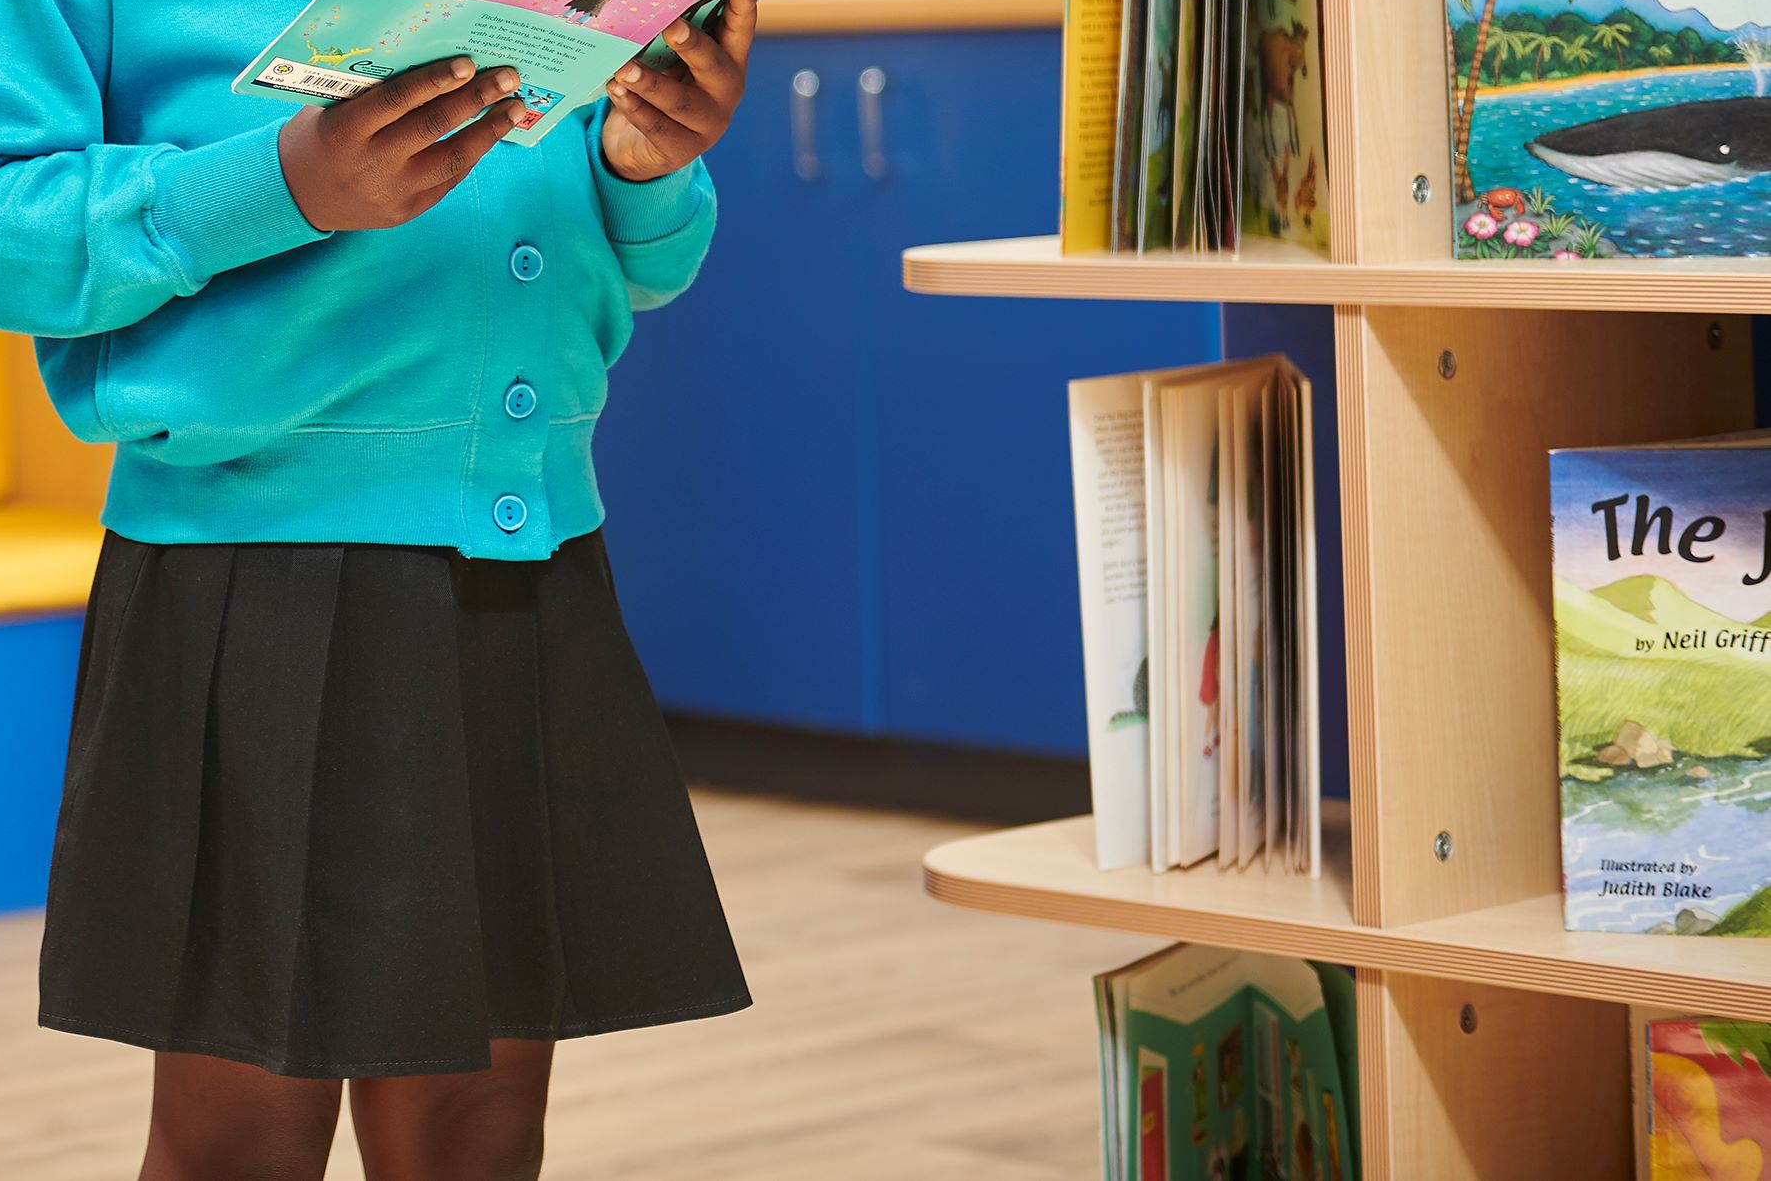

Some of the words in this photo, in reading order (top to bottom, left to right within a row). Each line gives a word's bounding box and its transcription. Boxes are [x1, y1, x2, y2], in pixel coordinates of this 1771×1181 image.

[496, 34, 513, 42] little
[541, 45, 556, 53] But
[556, 51, 577, 60] when
[549, 30, 576, 41] haircut
[577, 39, 596, 48] turns
[557, 42, 574, 50] fixes
[489, 51, 506, 59] help
[1591, 493, 1727, 563] The
[1636, 637, 1655, 652] by
[1663, 630, 1707, 650] Neil
[1600, 858, 1676, 874] Illustrated
[1680, 861, 1698, 876] by
[1598, 880, 1656, 897] Judith
[1662, 881, 1713, 898] Blake
